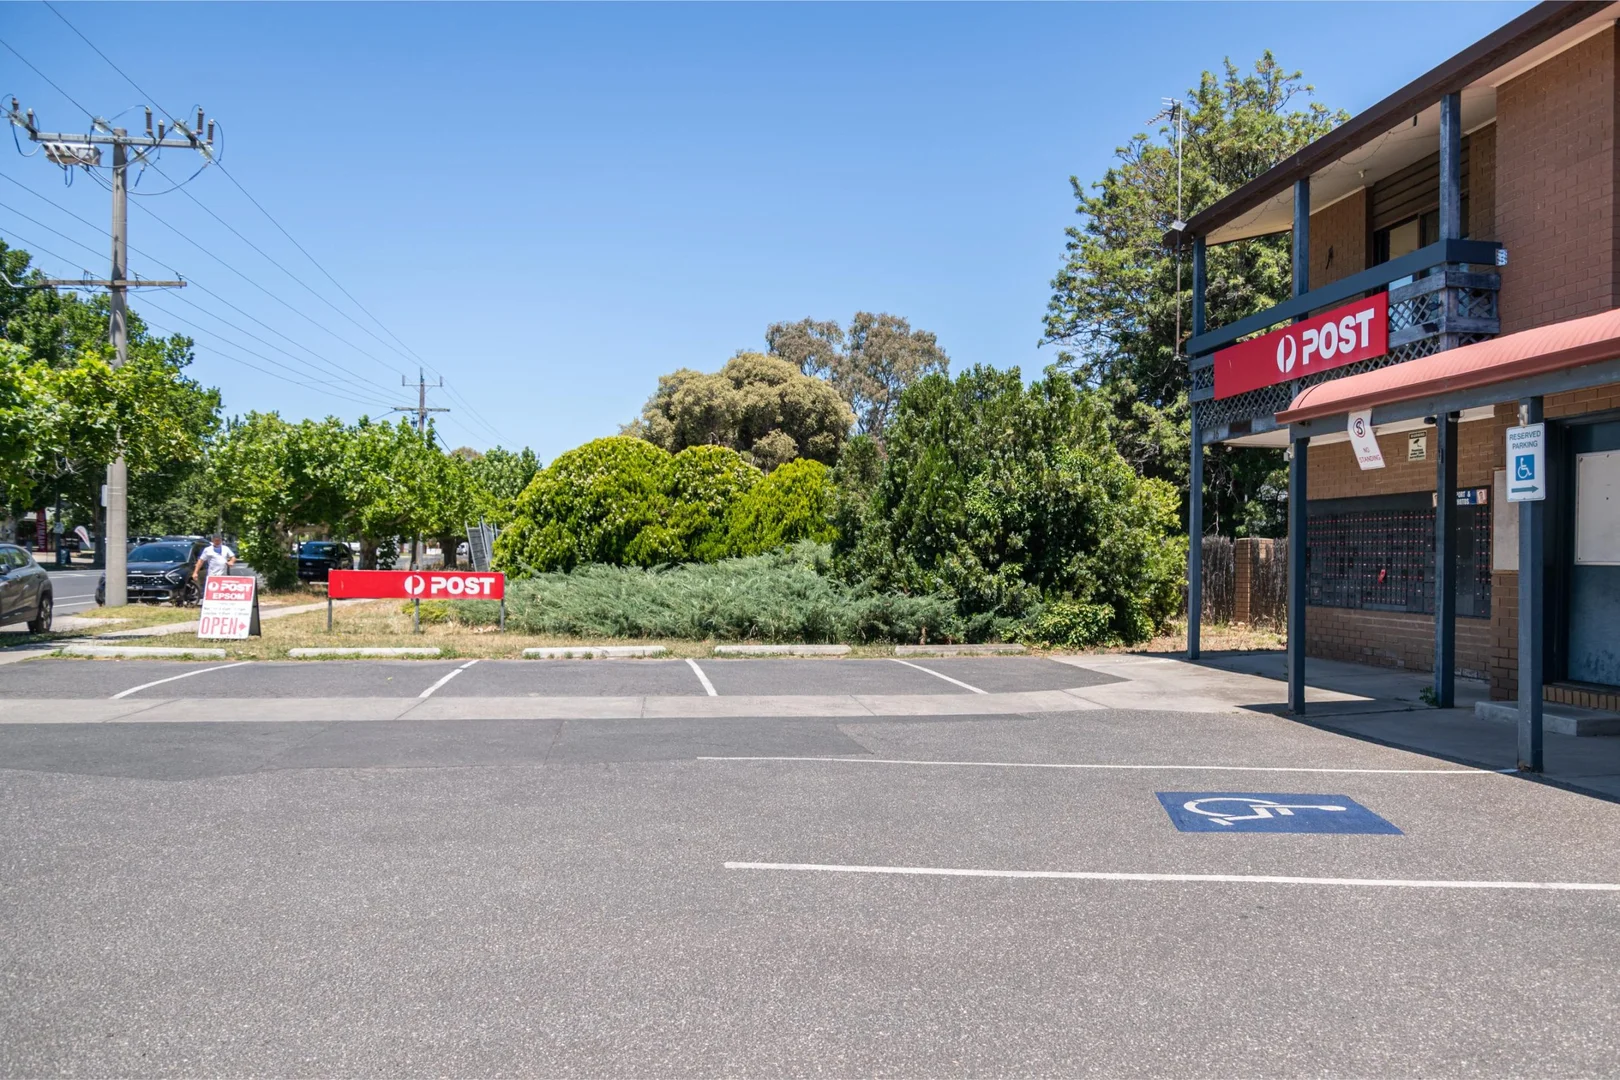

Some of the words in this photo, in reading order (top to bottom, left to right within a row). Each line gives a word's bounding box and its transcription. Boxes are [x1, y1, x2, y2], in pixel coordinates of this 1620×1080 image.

[1302, 307, 1375, 365] POST
[1509, 430, 1541, 440] RESERVED
[1512, 440, 1538, 449] PARKING
[1359, 455, 1381, 463] STANDING
[220, 583, 253, 592] POST
[430, 576, 495, 595] POST
[212, 592, 246, 600] EPSOM
[200, 616, 239, 635] OPEN
